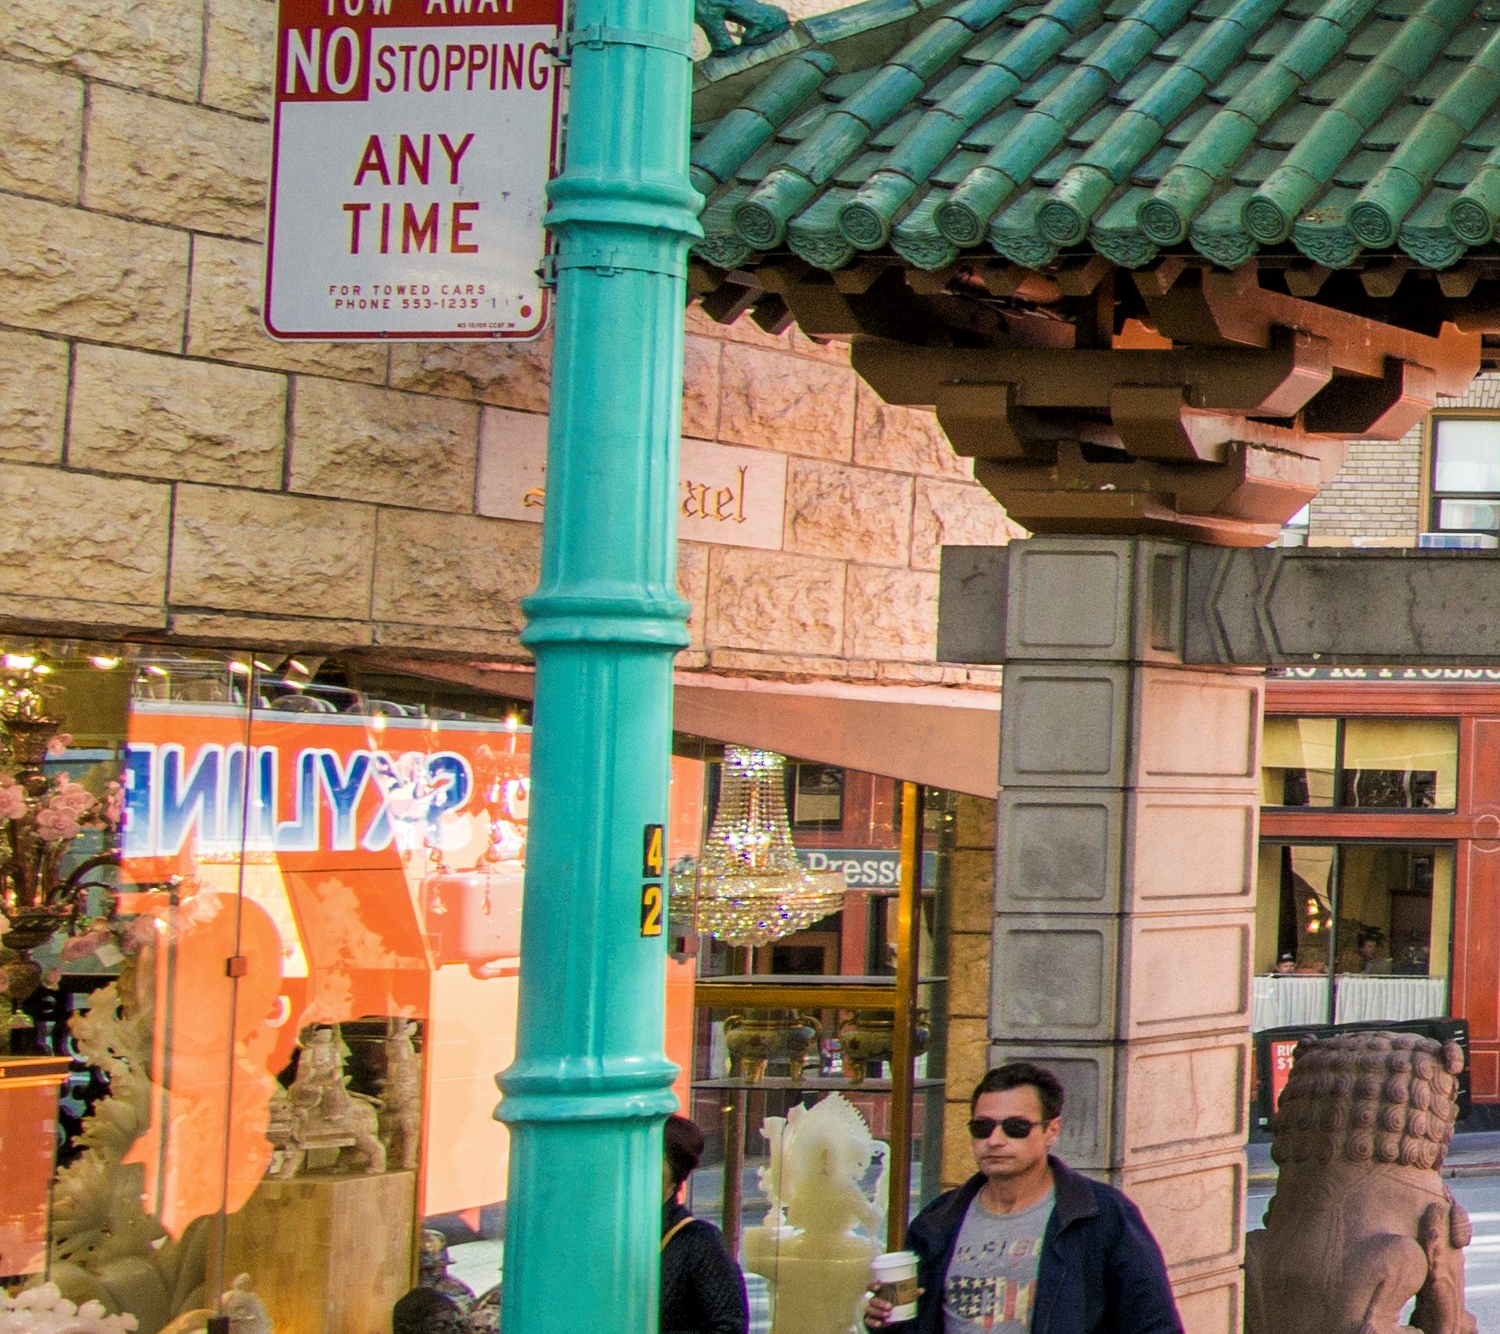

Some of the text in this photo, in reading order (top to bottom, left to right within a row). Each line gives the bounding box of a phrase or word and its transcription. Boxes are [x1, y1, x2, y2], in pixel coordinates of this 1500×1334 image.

[285, 26, 550, 94] NO STOPPING
[353, 133, 476, 186] ANY
[342, 202, 480, 255] TIME
[329, 284, 486, 295] FOR TOWED CARS
[335, 299, 479, 309] PHONE 553-1235
